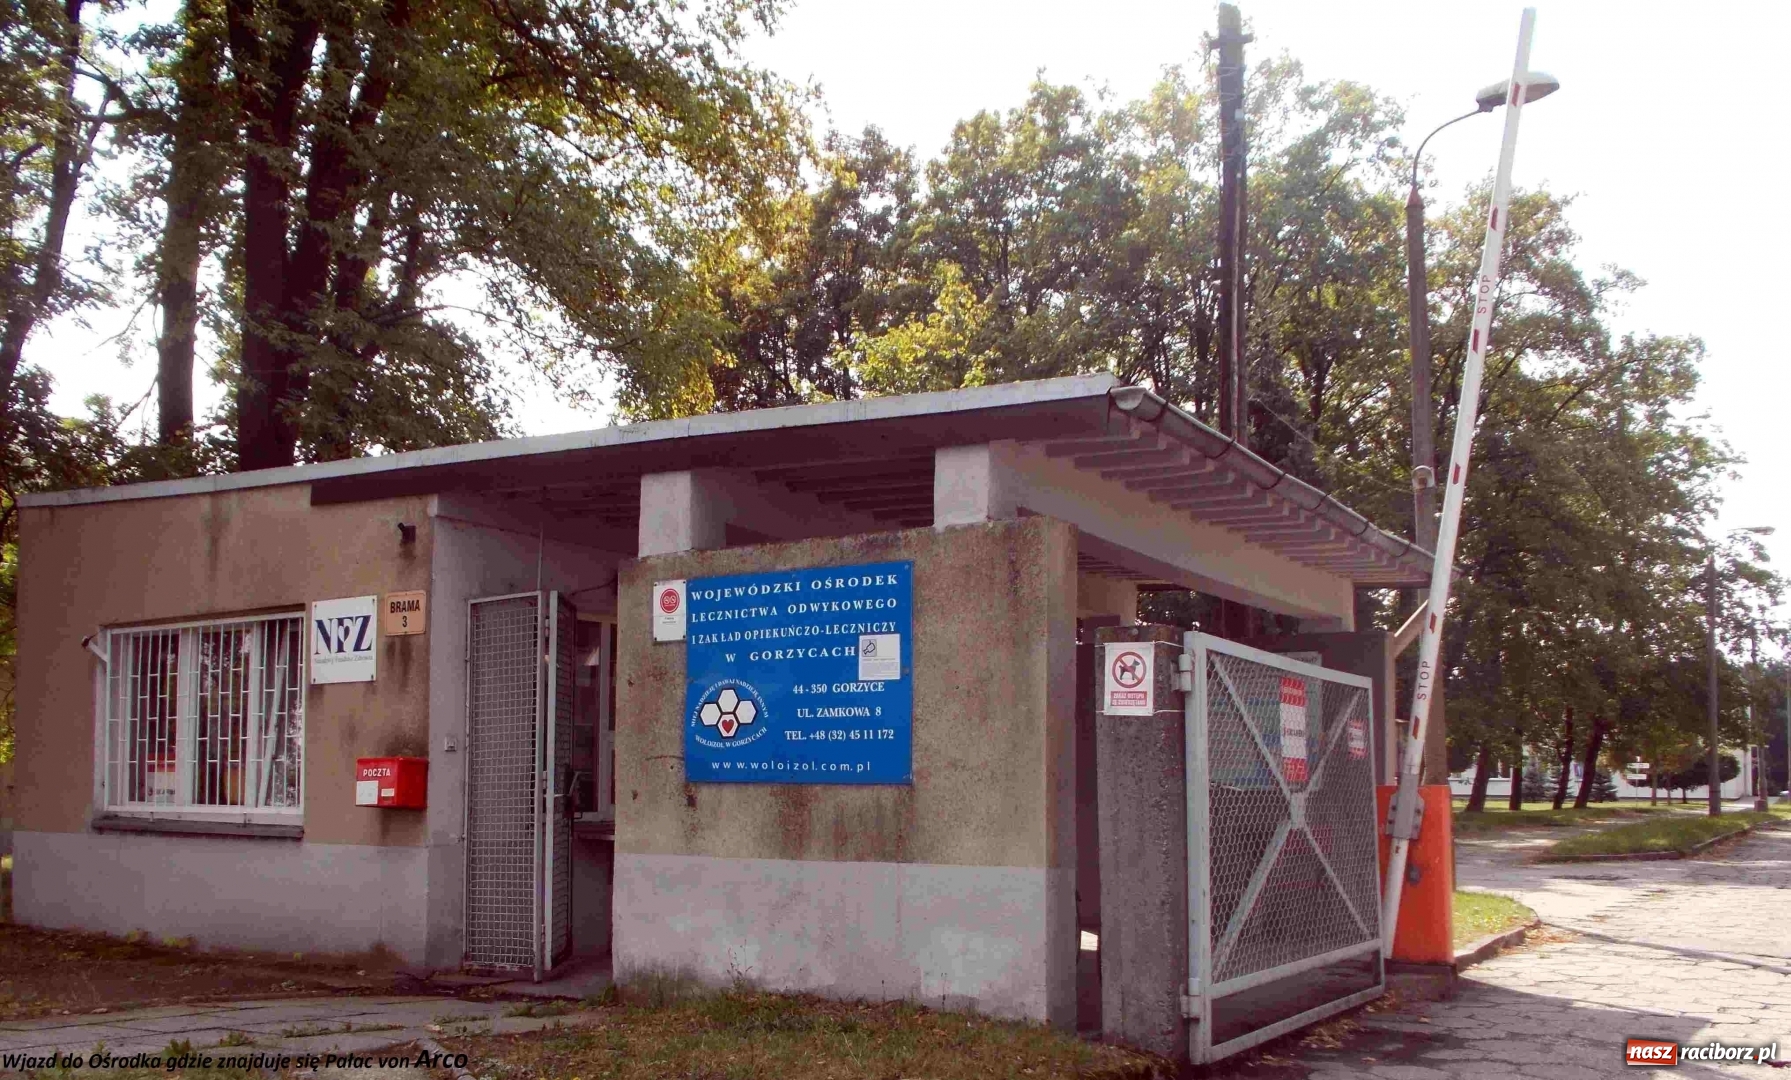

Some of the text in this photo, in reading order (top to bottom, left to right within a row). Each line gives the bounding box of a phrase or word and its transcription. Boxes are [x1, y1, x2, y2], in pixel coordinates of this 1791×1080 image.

[1477, 275, 1491, 314] STOP
[691, 574, 898, 602] WOJEWÓDZKI OŚRODEK
[390, 599, 421, 613] BRAMA
[692, 606, 778, 623] LECZNICTWA
[787, 598, 897, 614] ODWYKOWEGO
[402, 615, 408, 628] 3
[313, 614, 374, 655] NFZ
[691, 621, 896, 645] I ZAKŁAD OPIEKUŃCZO-LECZNICZY
[725, 646, 856, 663] W GORZYCACH
[832, 681, 885, 693] GORZYCE
[1416, 660, 1431, 701] STOP
[797, 706, 882, 718] UL. ZAMKOWA 8
[731, 726, 768, 748] GORZYCACH
[784, 729, 894, 742] TEL. +48 (32) 45 11 172
[362, 768, 391, 777] POCZTA
[711, 760, 871, 773] www.woloizol.com.pl
